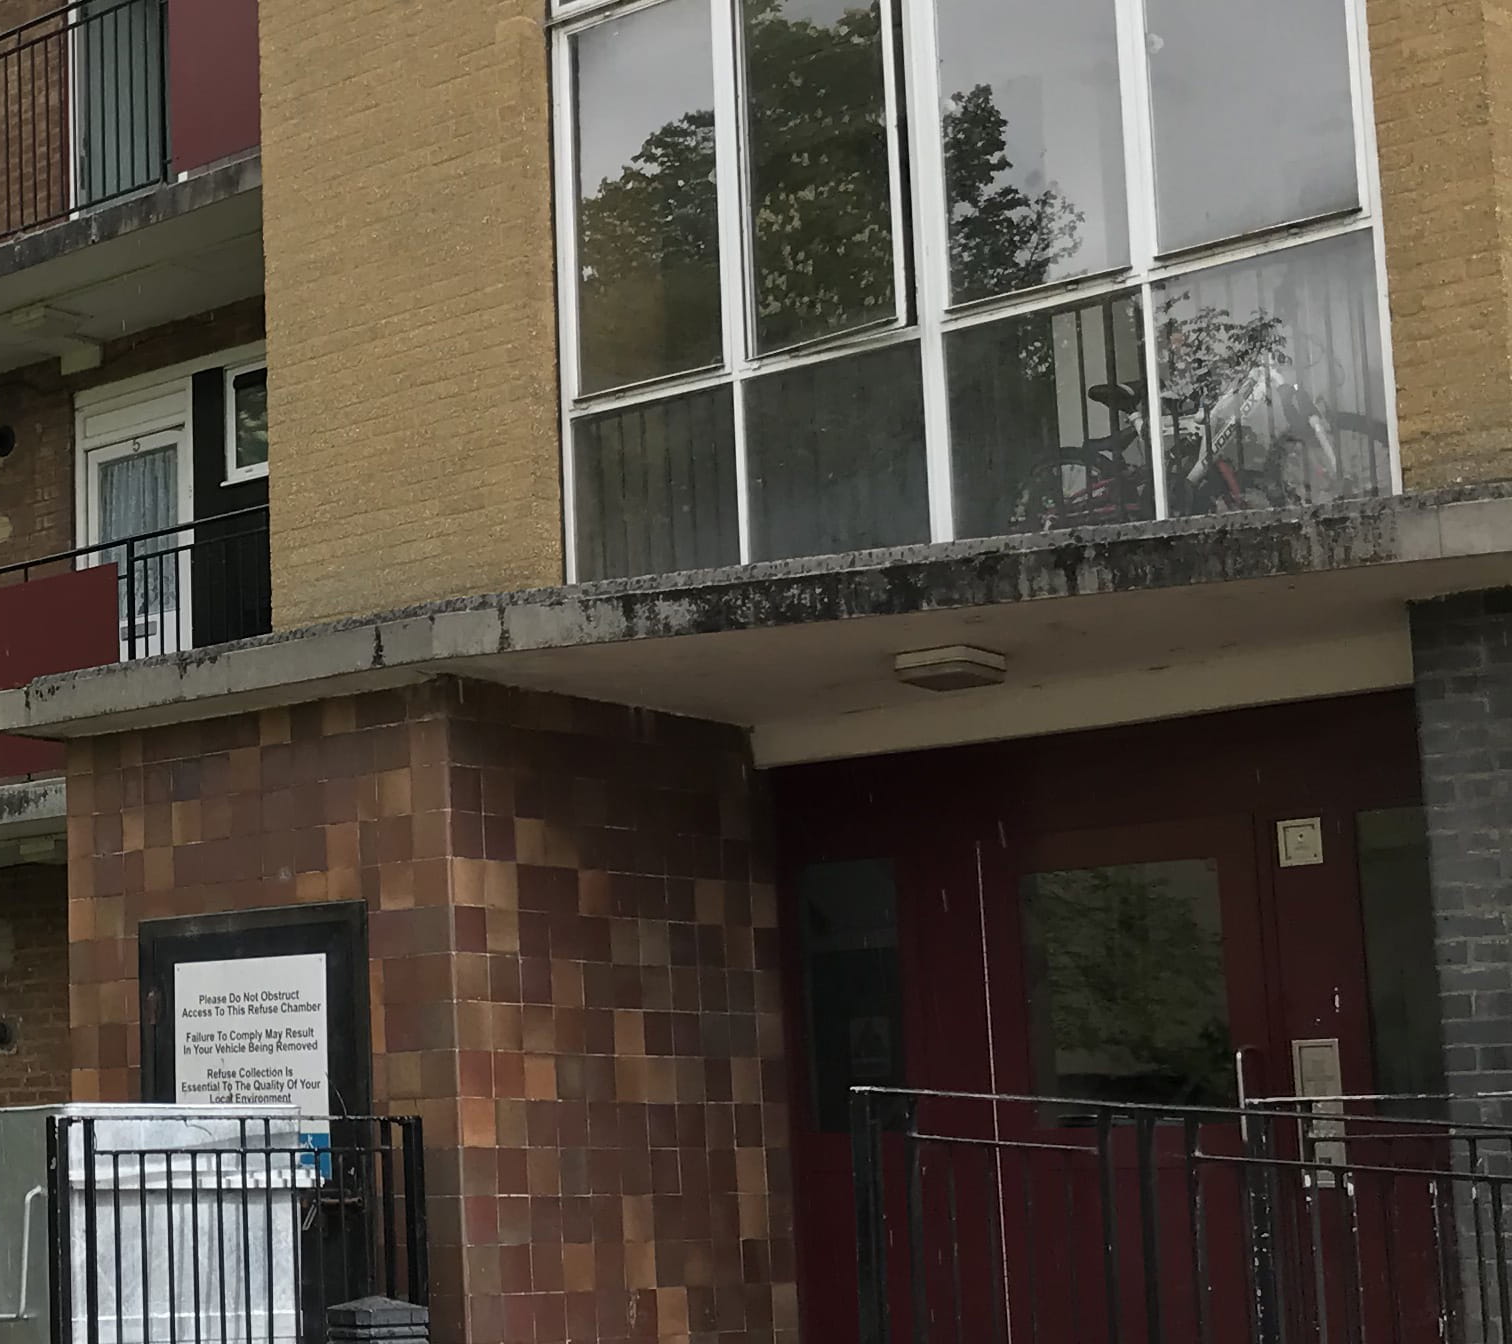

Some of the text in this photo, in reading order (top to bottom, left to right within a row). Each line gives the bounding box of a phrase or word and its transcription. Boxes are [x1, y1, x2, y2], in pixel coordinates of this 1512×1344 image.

[133, 439, 141, 452] 5
[199, 990, 299, 1004] Please Do Not Obstruct
[182, 1002, 321, 1018] Access To This Refuse Chamber
[186, 1027, 314, 1042] Failure To Comply May Result
[184, 1040, 317, 1055] In Your Vehicle Being Removed
[207, 1066, 293, 1079] Refuse Collection Is
[182, 1079, 320, 1092] Essential To The Quality Of Your
[210, 1093, 292, 1104] Local Environment
